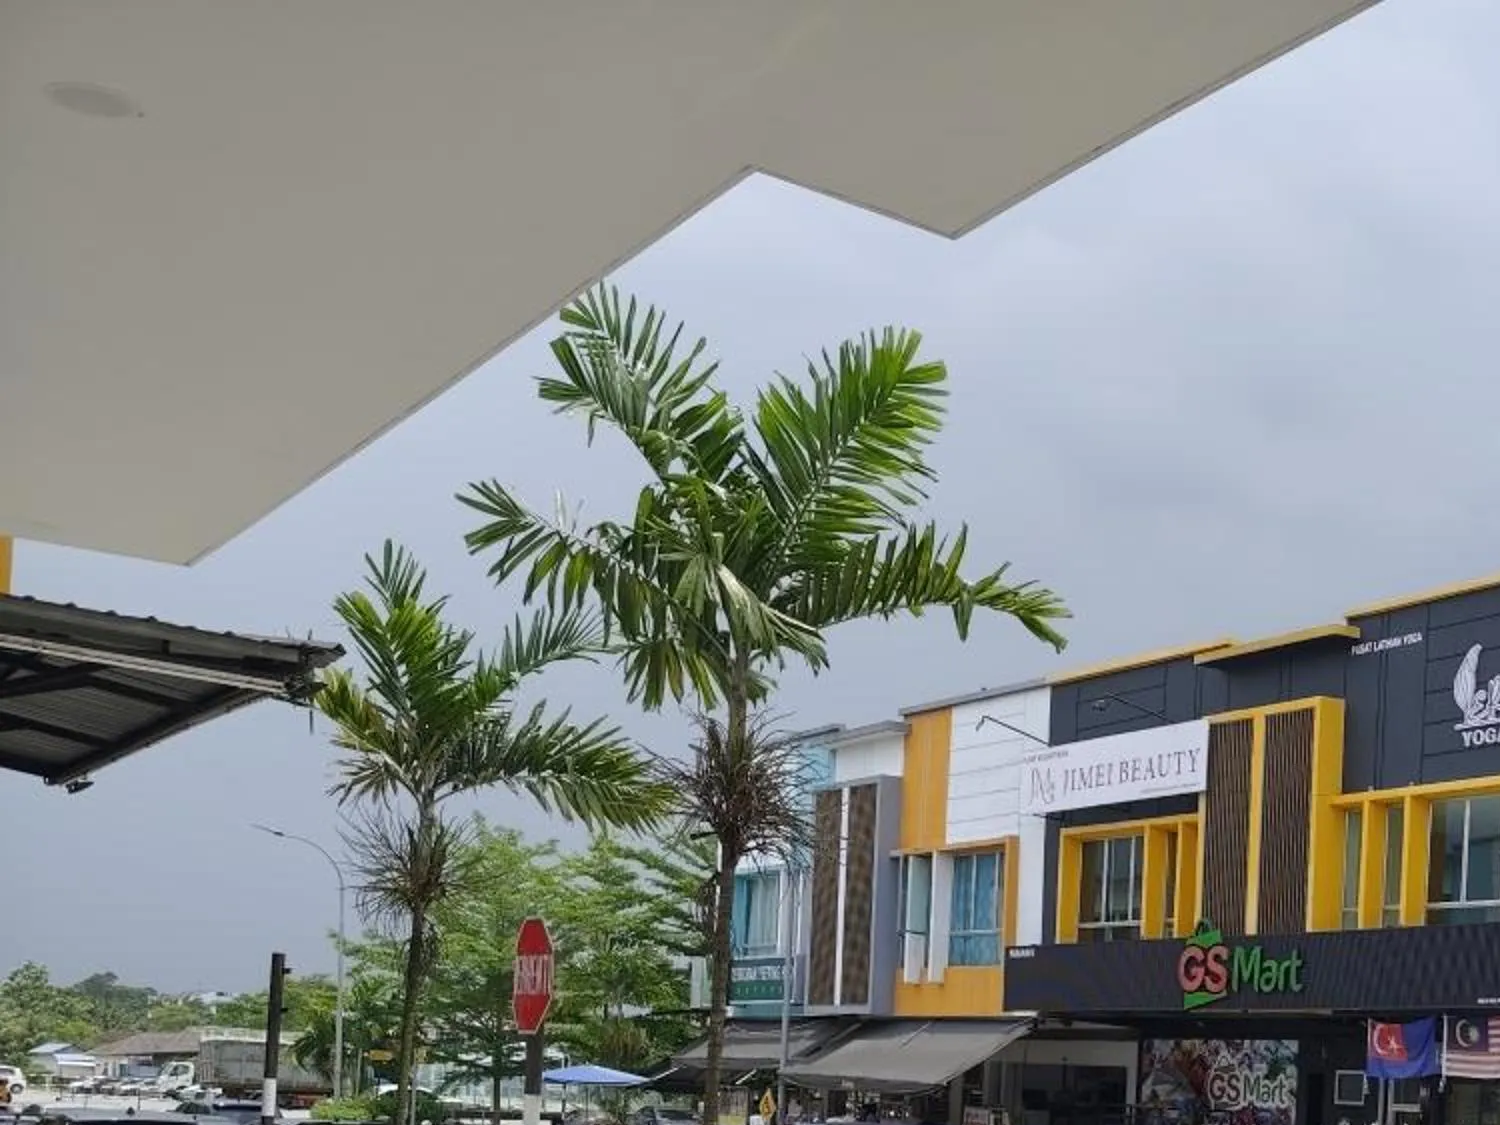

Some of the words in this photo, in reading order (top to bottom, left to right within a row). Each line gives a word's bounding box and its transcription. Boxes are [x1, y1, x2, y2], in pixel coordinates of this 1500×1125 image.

[1118, 747, 1201, 785] BEAUTY
[1178, 945, 1230, 993] GS
[1231, 945, 1304, 993] Mart
[1209, 1073, 1240, 1103] GS
[1242, 1071, 1288, 1107] Mart
